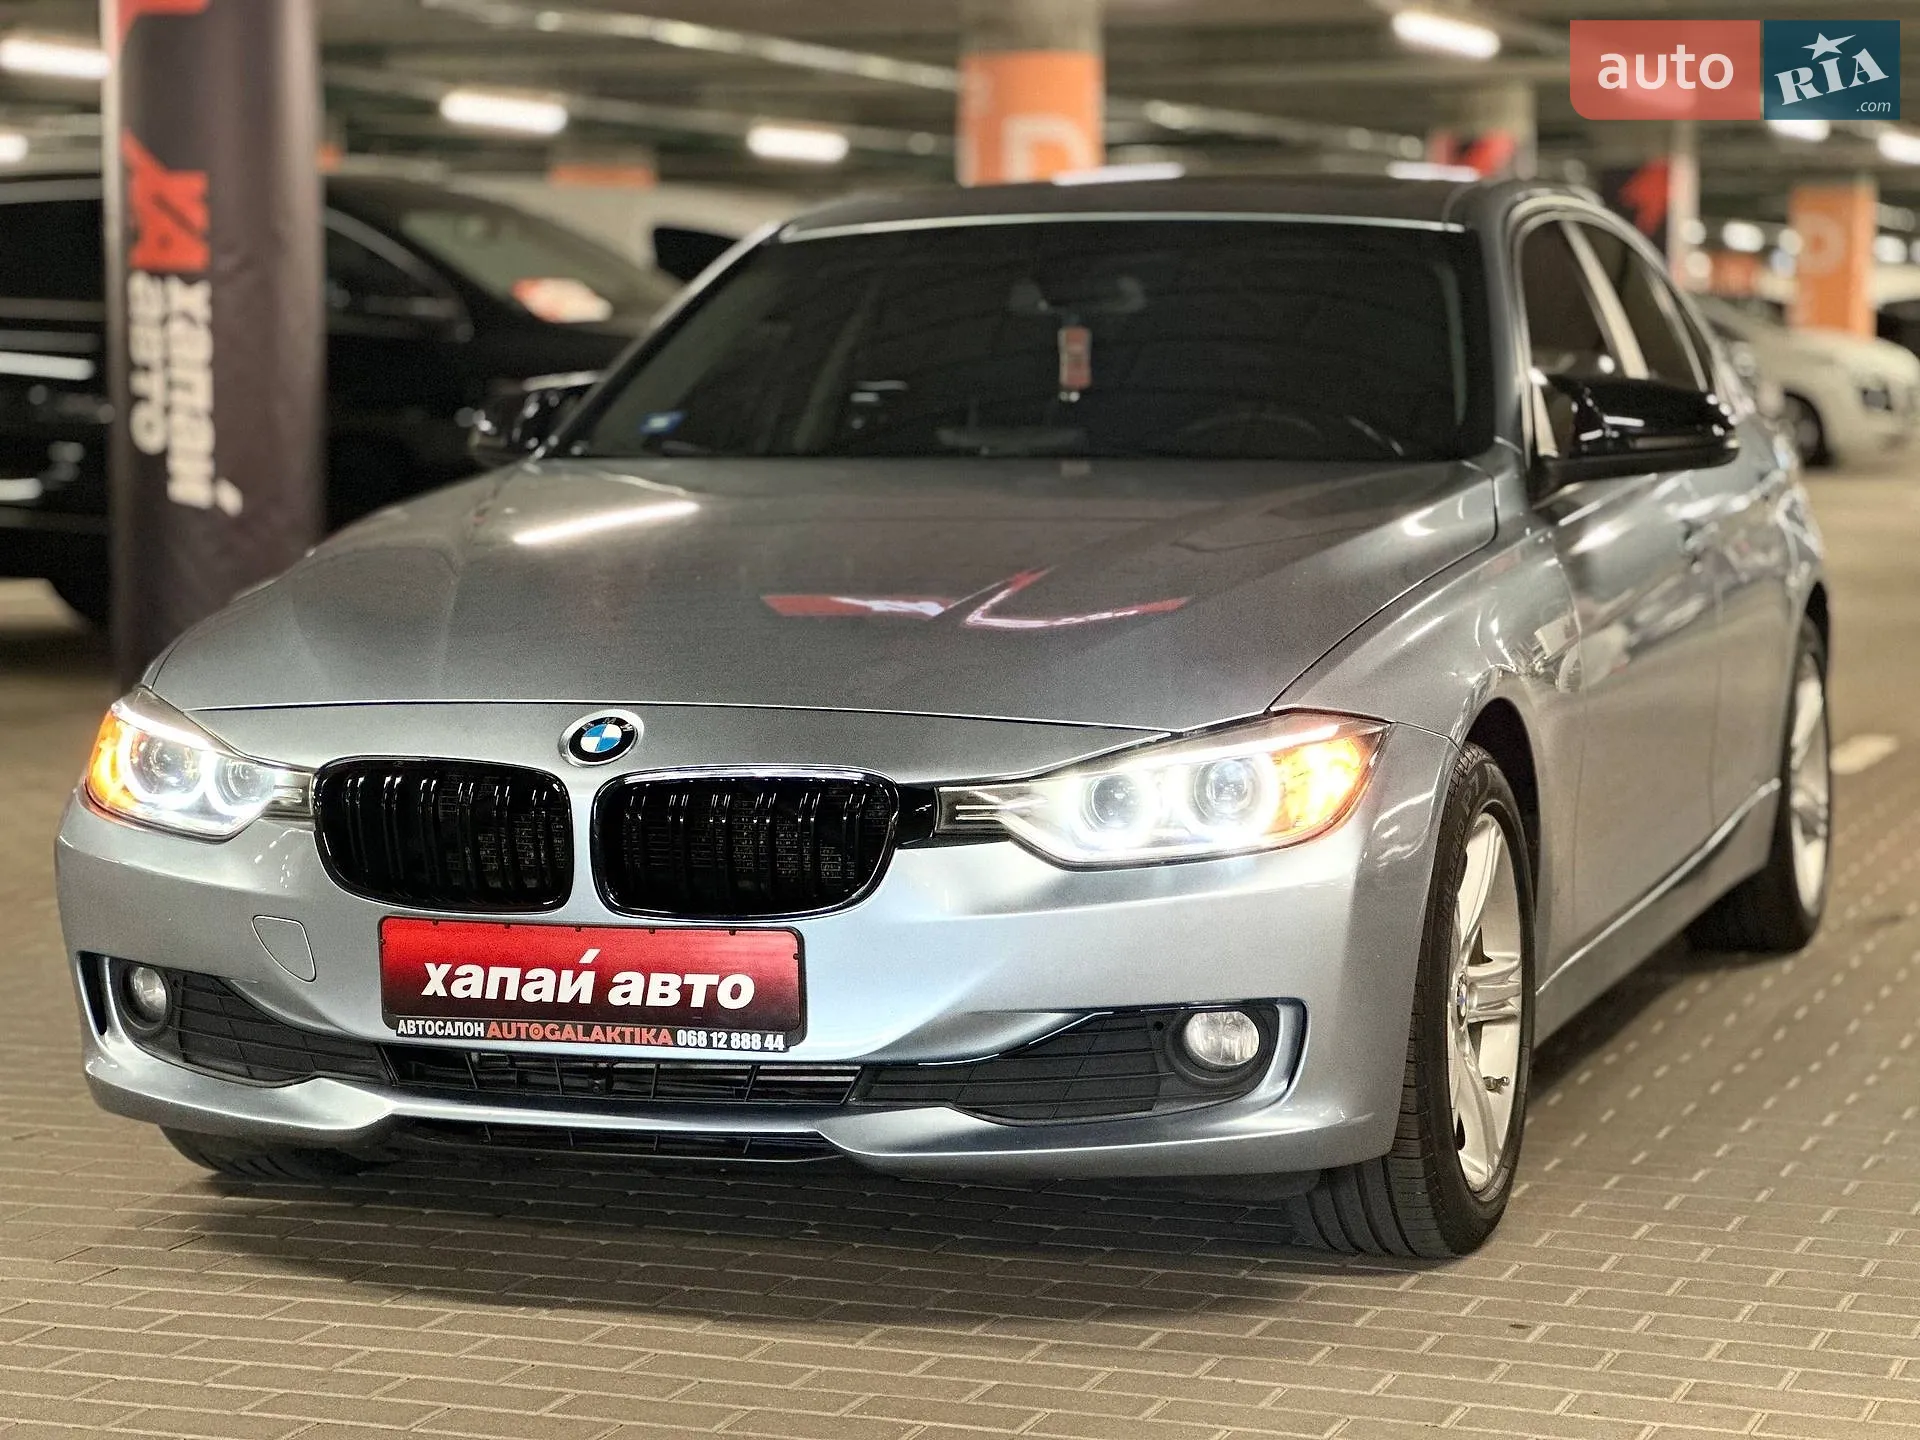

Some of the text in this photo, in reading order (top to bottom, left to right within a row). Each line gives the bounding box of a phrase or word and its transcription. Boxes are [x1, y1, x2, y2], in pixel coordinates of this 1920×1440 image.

[608, 970, 755, 1010] авто
[397, 1019, 485, 1037] АВТОСАЛОН
[486, 1021, 674, 1046] AUTOGALAKTIKA
[676, 1029, 707, 1047] 068
[710, 1031, 727, 1048] 12
[764, 1034, 785, 1052] 44
